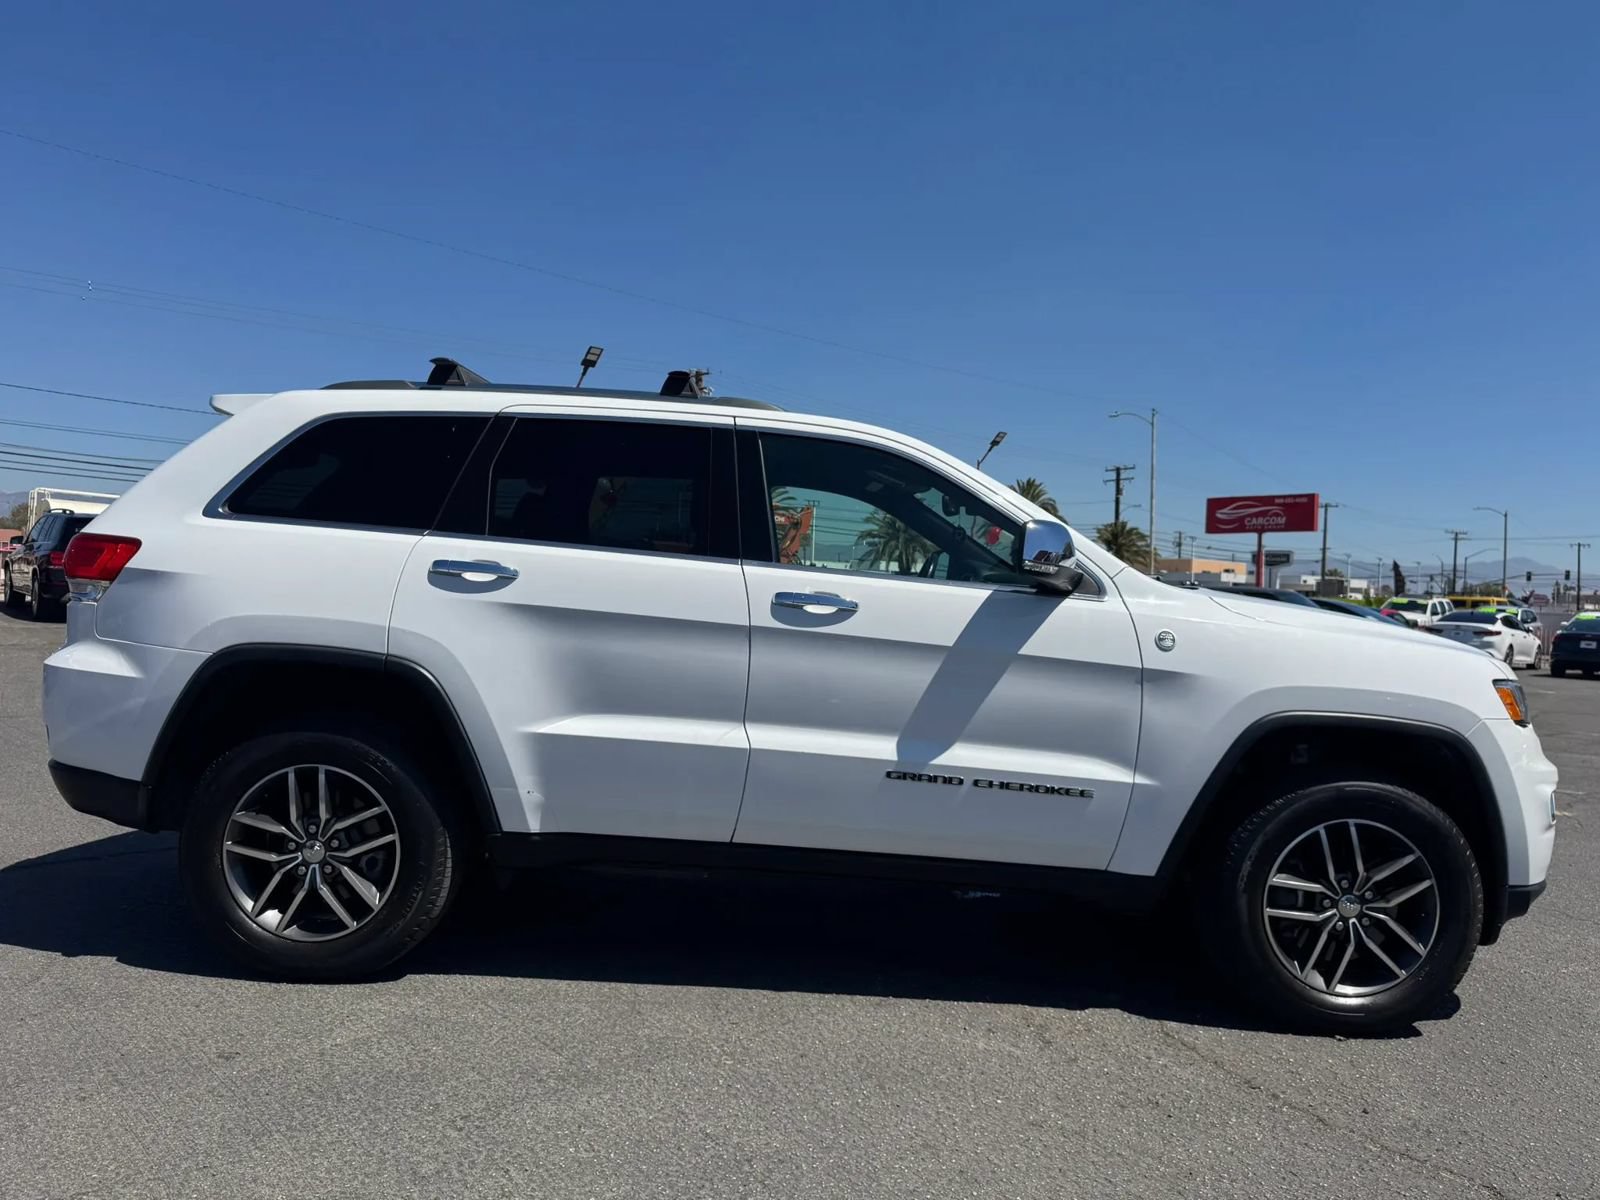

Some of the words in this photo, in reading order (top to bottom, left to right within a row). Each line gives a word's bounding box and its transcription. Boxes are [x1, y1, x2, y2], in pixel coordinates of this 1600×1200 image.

[1245, 517, 1286, 526] CARCOM
[885, 770, 964, 786] GRAND
[972, 778, 1095, 799] CHEROKEE
